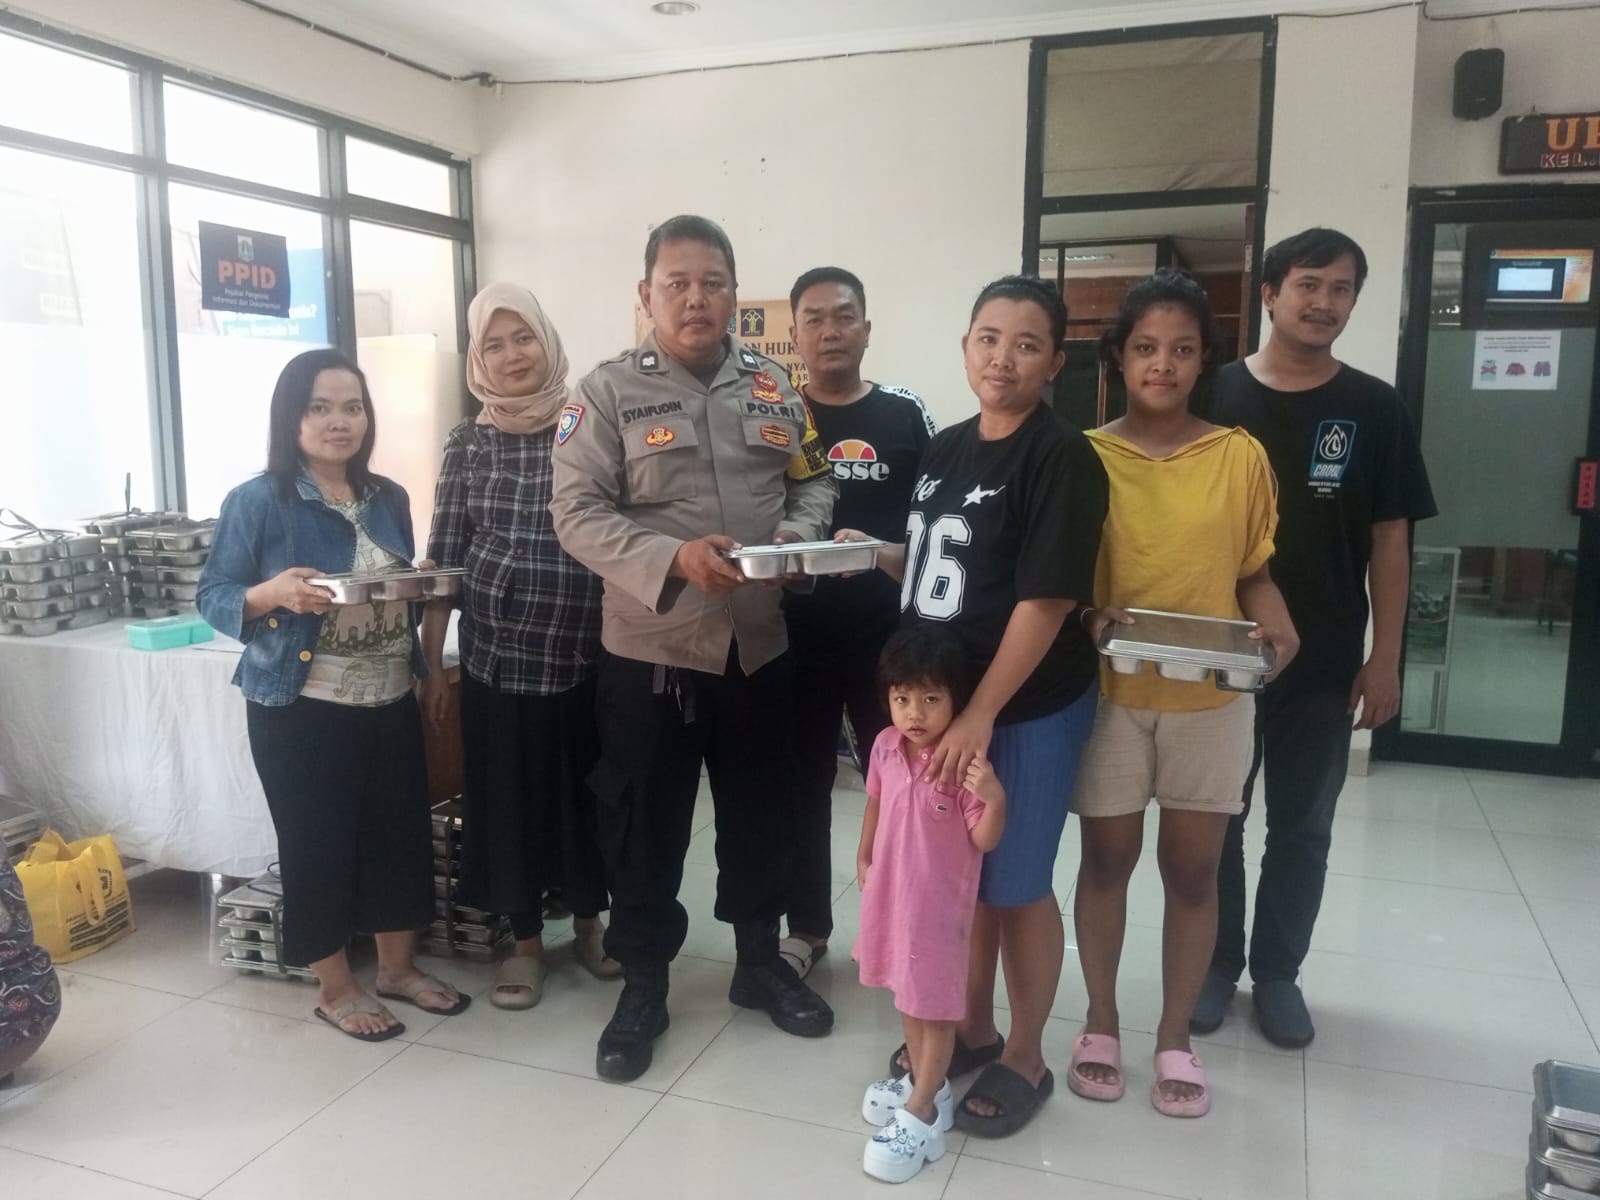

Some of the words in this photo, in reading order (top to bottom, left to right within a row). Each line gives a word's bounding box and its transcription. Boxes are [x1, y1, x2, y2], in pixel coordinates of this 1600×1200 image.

[217, 259, 277, 289] PPID
[623, 400, 682, 424] SYAIFUDIN
[746, 402, 796, 418] POLRI
